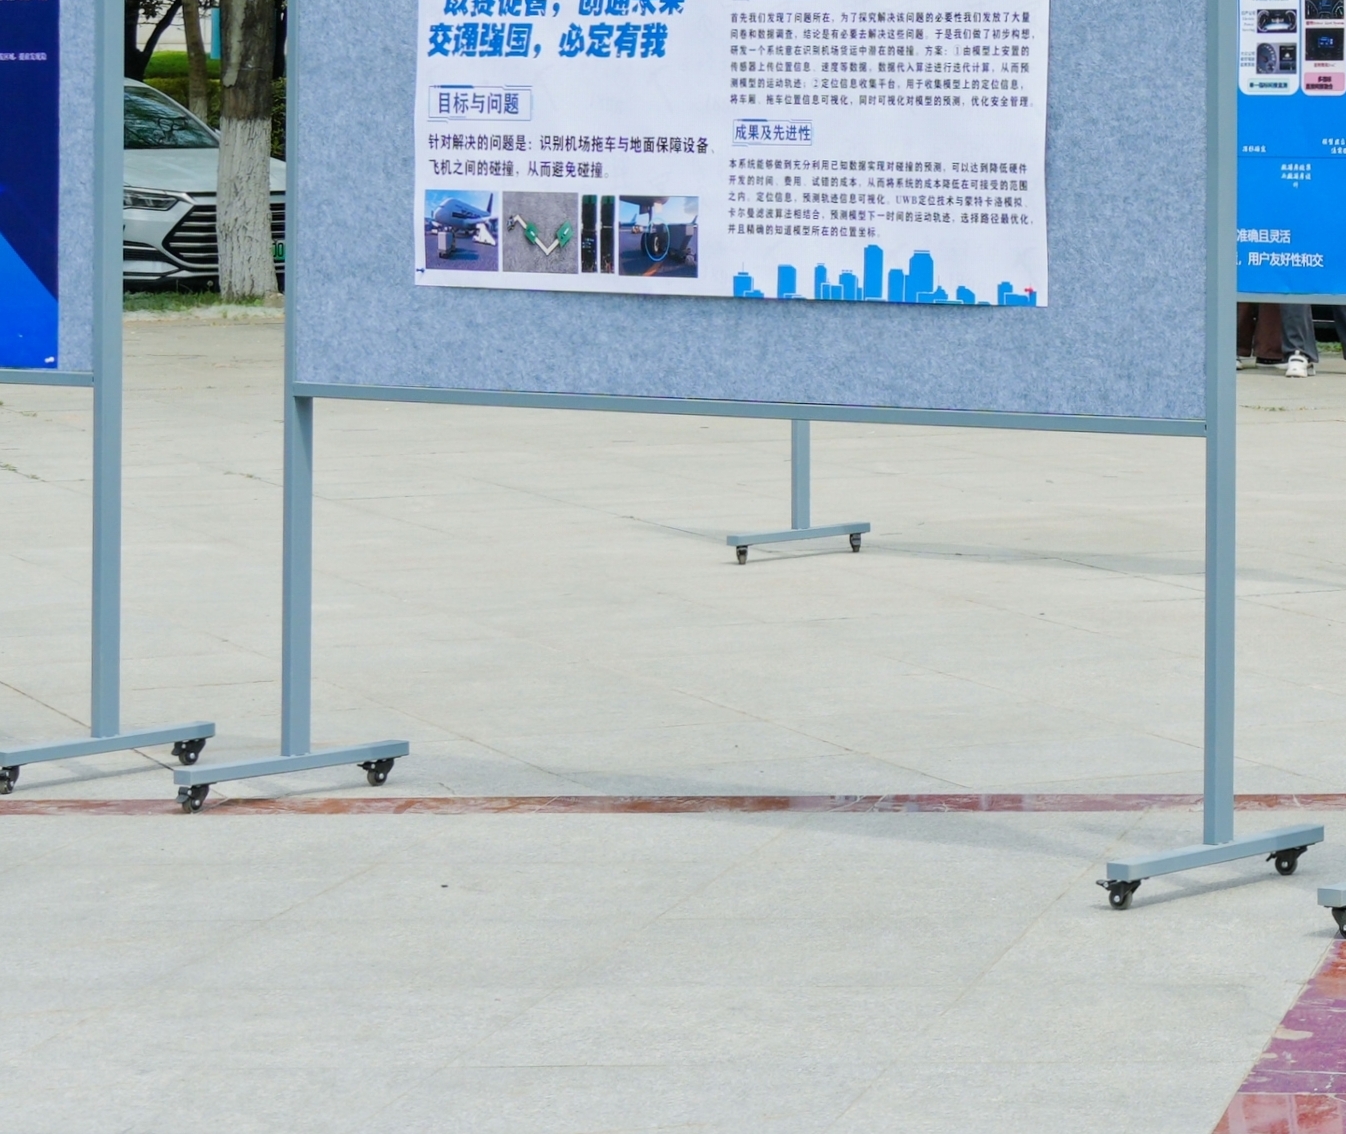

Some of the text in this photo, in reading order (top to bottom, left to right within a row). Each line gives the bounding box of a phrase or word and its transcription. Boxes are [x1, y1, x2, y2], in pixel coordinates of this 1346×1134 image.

[427, 22, 669, 59] 交通强国，必定有我
[438, 92, 519, 115] 目标与问题
[734, 125, 811, 142] 成果及先进性
[429, 159, 611, 179] 飞机之间的碰撞，从而避免碰撞。
[1237, 228, 1291, 244] 准确且灵活
[1236, 250, 1324, 268] ，用户友好性和交
